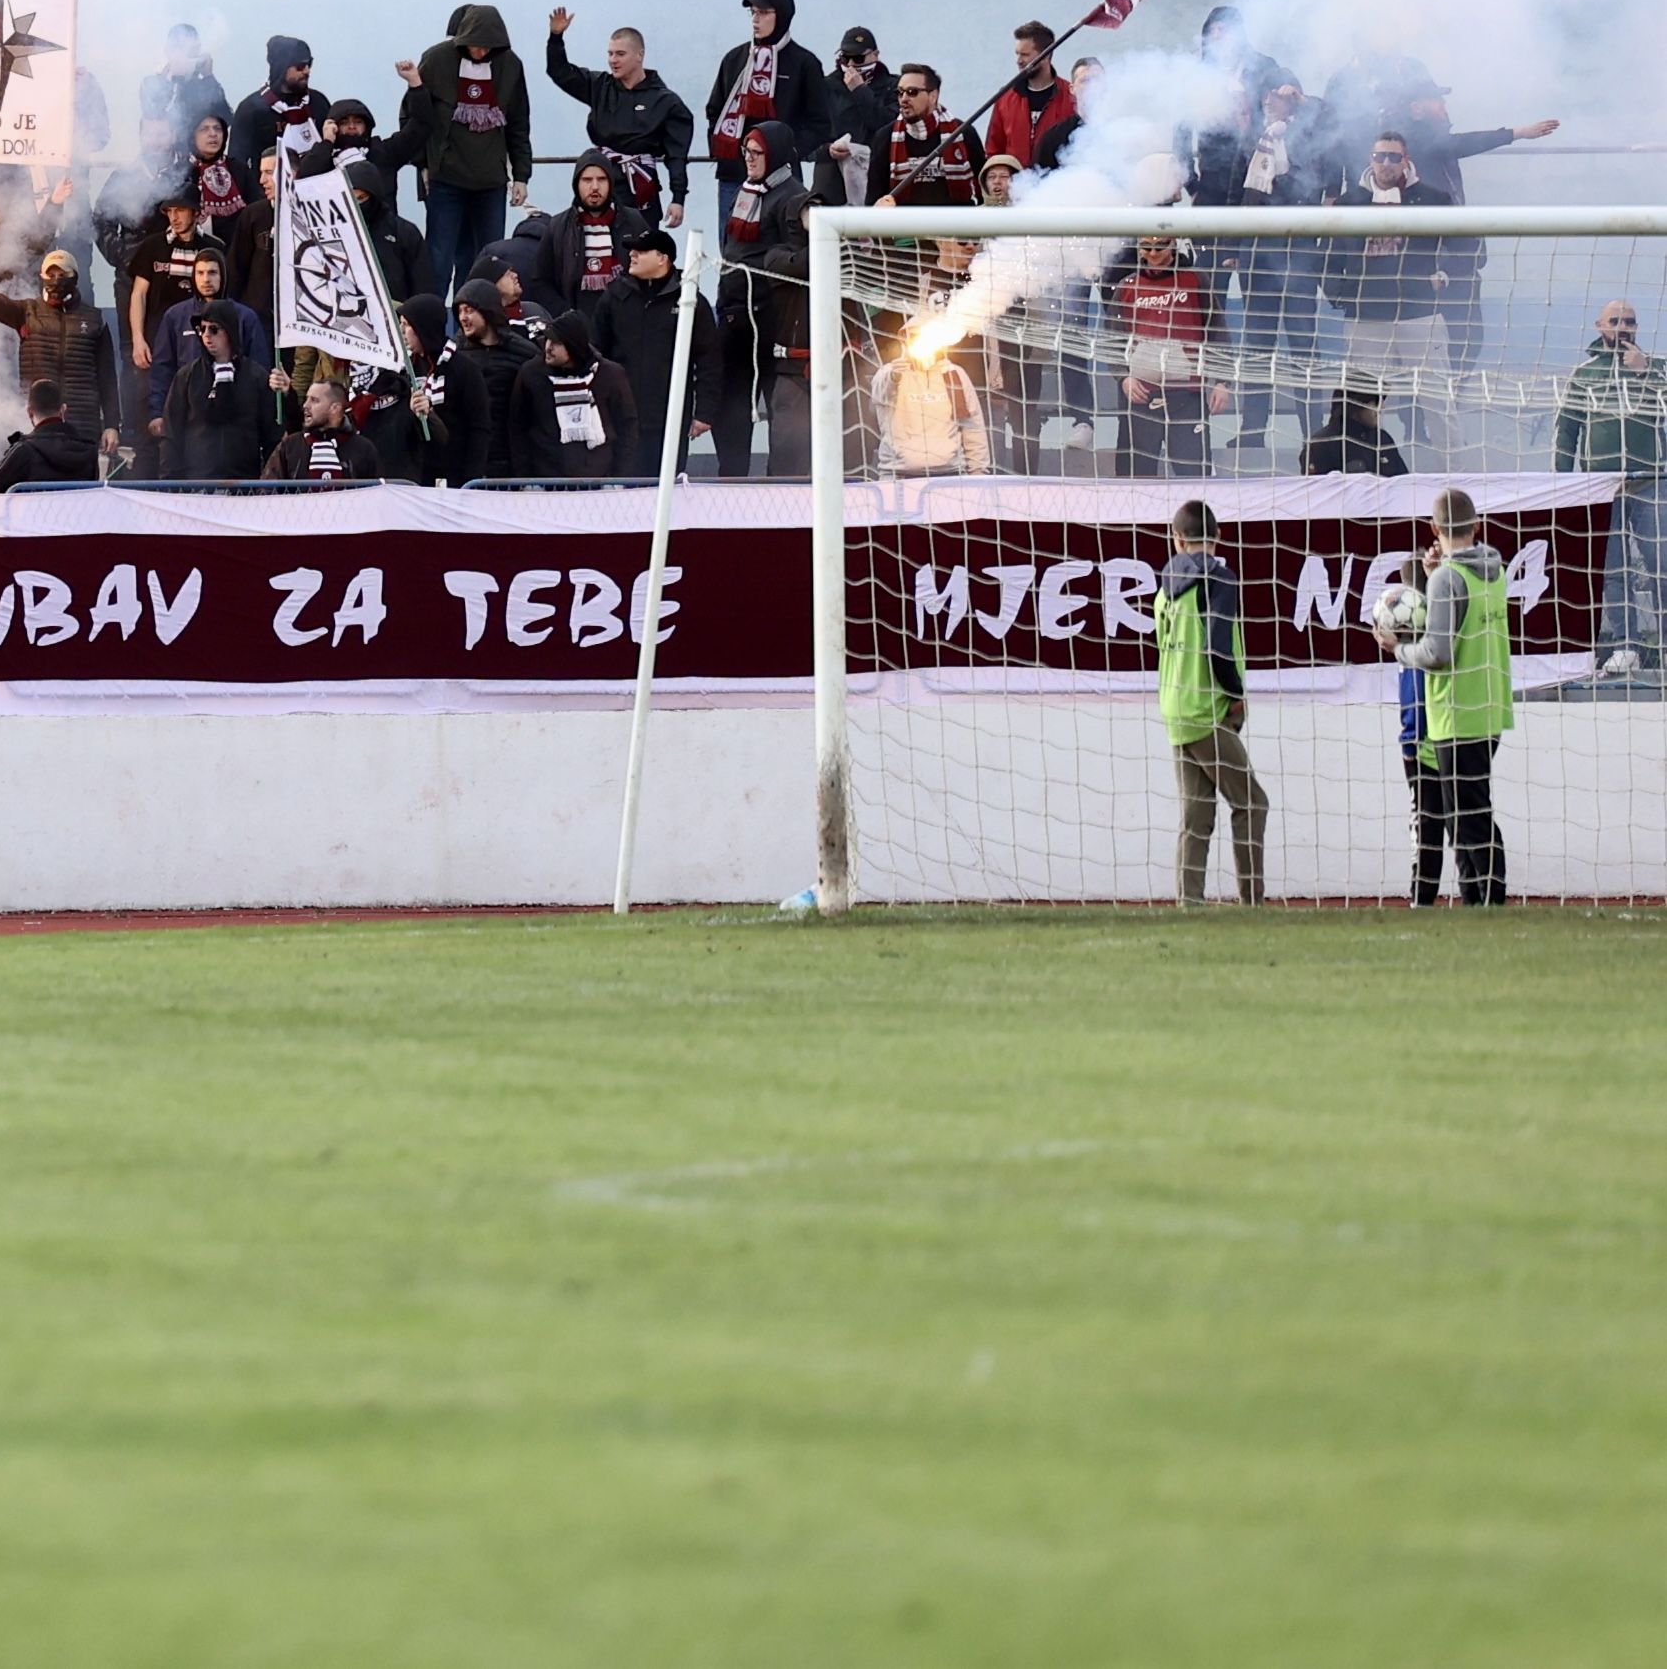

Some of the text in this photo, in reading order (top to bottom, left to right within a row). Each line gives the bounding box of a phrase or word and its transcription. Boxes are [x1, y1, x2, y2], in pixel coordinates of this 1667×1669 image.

[14, 114, 36, 130] JE
[269, 565, 387, 648] ZA
[444, 565, 683, 651] TEBE
[914, 556, 1226, 641] MJER
